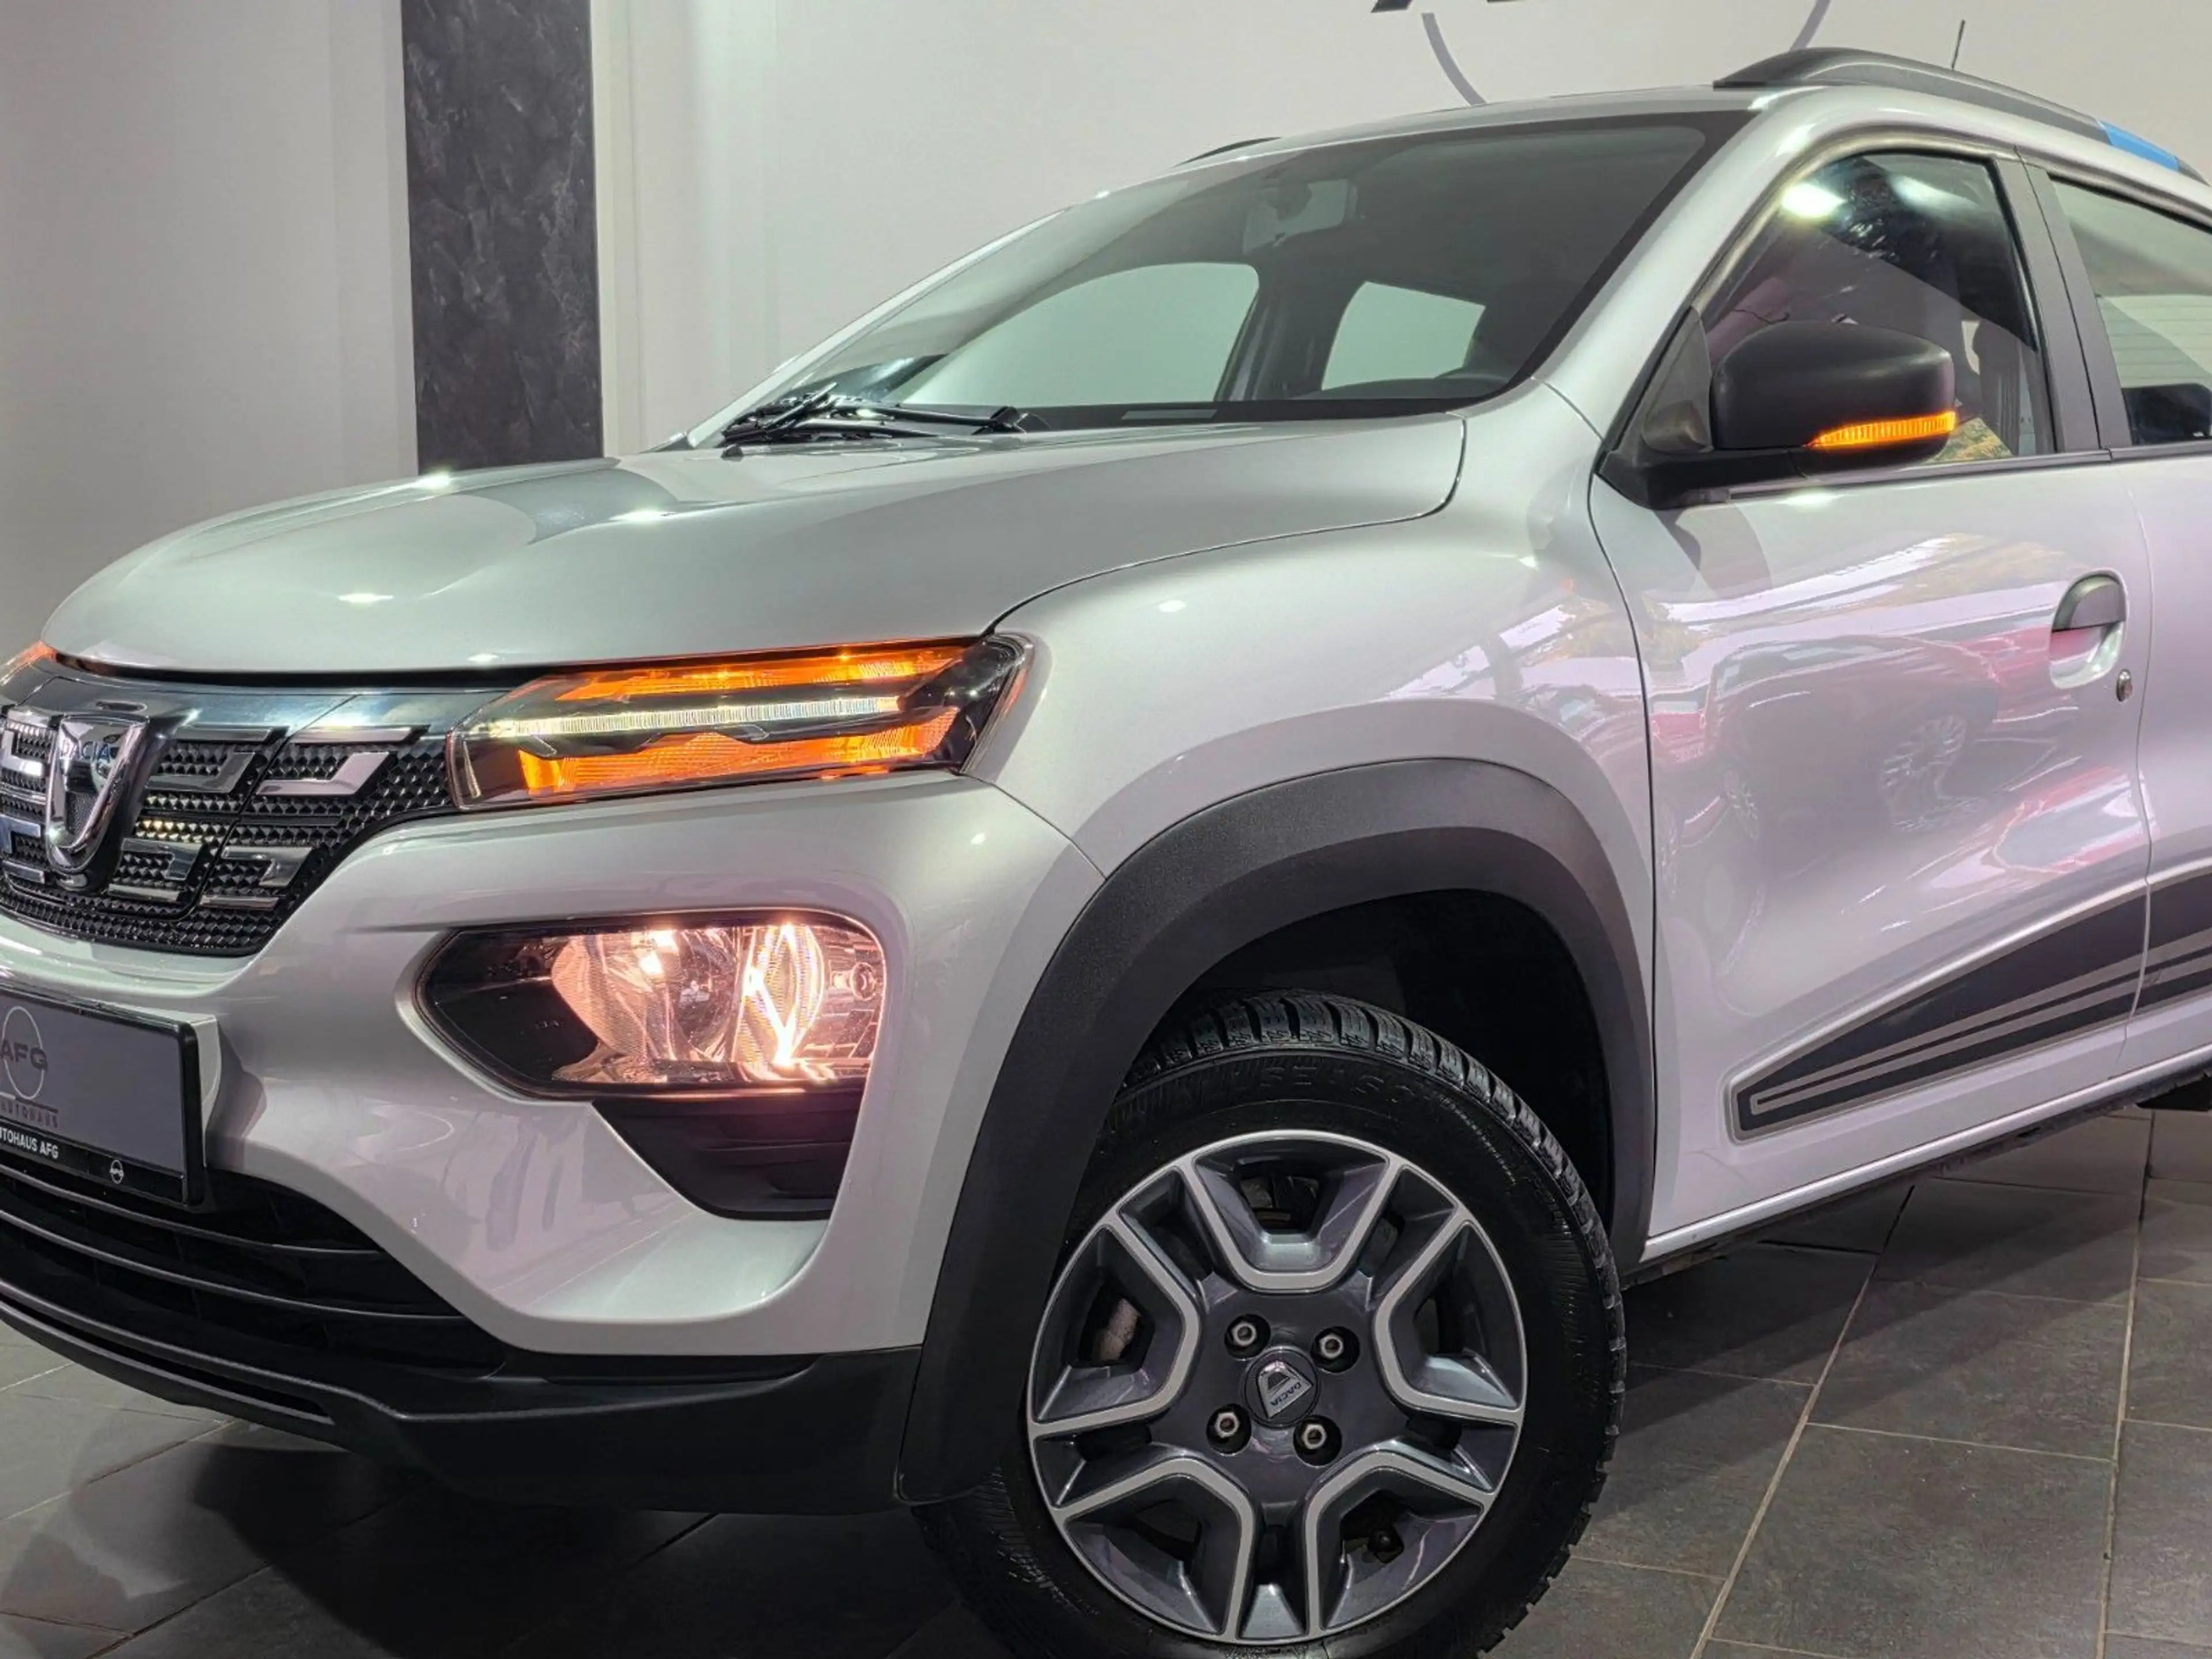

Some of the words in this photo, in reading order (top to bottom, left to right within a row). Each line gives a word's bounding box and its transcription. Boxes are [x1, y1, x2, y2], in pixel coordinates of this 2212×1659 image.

[60, 740, 111, 764] DACIA
[0, 1039, 48, 1072] AFG
[39, 1141, 58, 1159] AFG
[1270, 1381, 1302, 1406] DACIA
